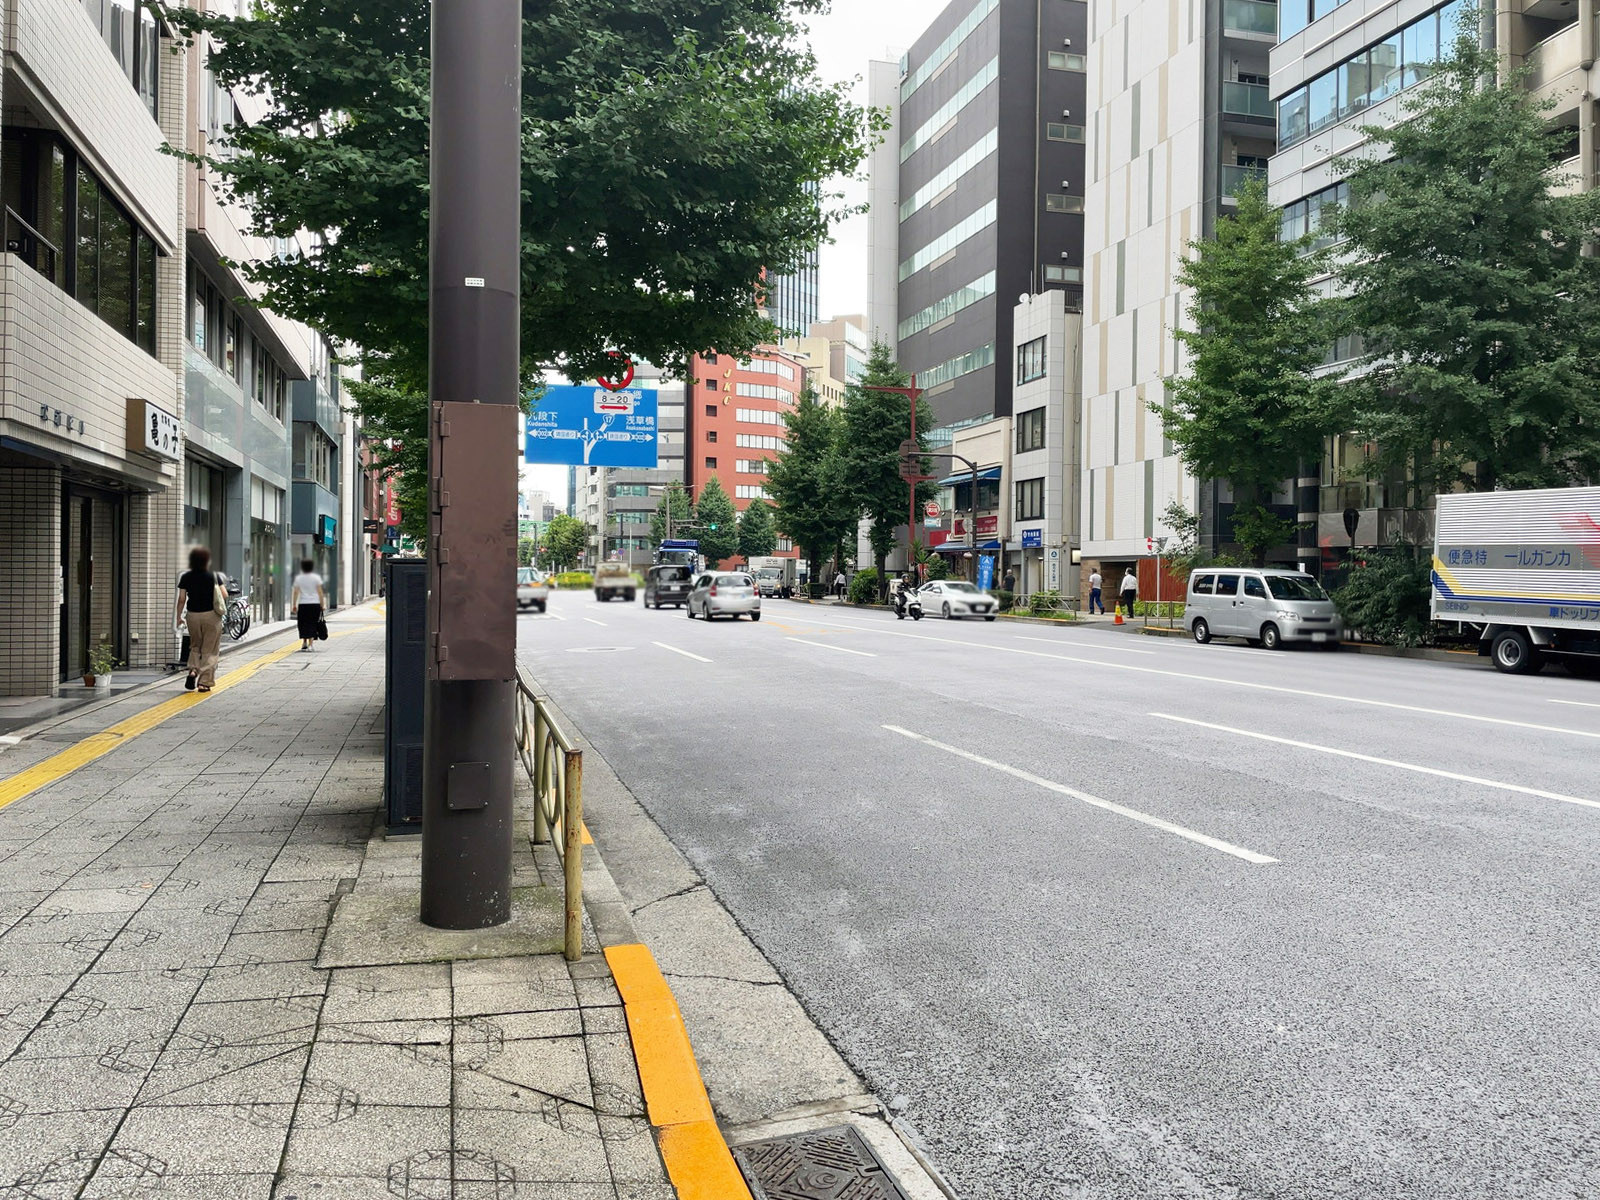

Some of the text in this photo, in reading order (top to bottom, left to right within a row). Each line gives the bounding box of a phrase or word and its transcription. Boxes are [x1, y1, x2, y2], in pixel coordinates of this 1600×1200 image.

[626, 415, 655, 426] 浅草橋
[1445, 602, 1469, 611] SEINO
